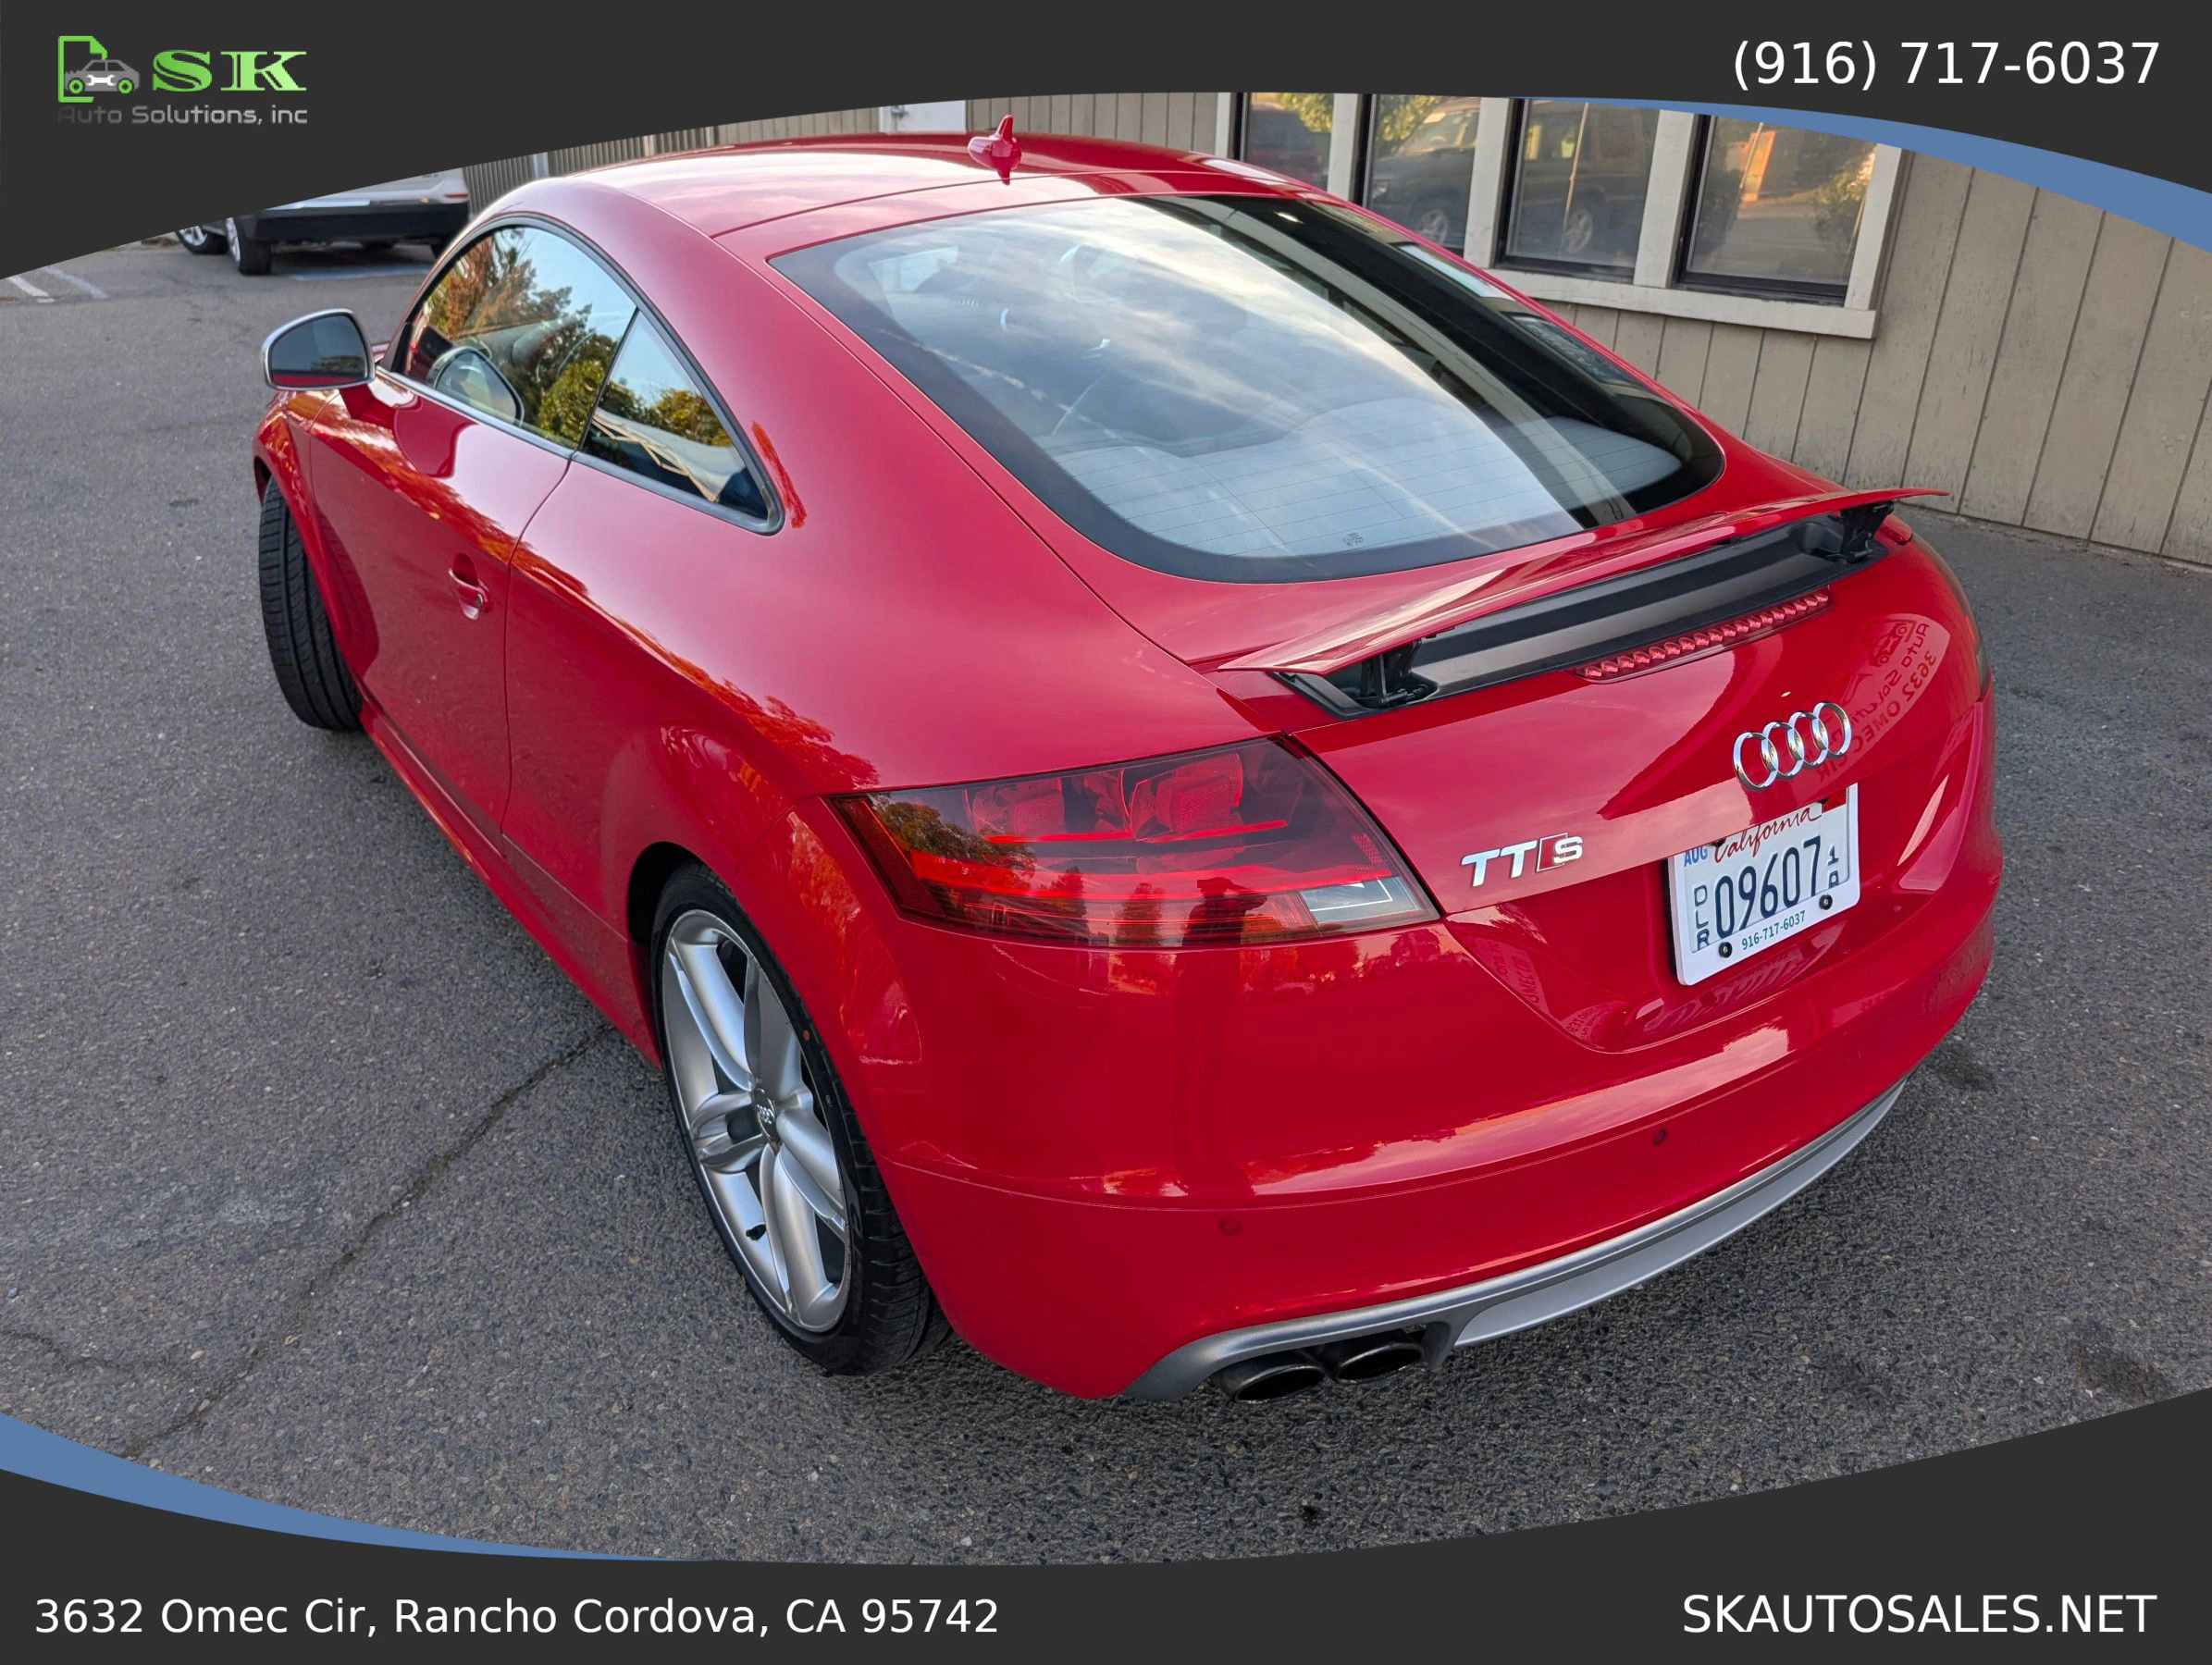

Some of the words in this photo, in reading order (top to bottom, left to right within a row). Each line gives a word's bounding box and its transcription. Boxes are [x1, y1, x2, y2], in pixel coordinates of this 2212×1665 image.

[1461, 833, 1583, 888] TTS
[1684, 845, 1708, 868] AUG
[1713, 806, 1822, 863] California
[1714, 834, 1822, 940] 09607
[1741, 909, 1806, 950] 916-717-6037
